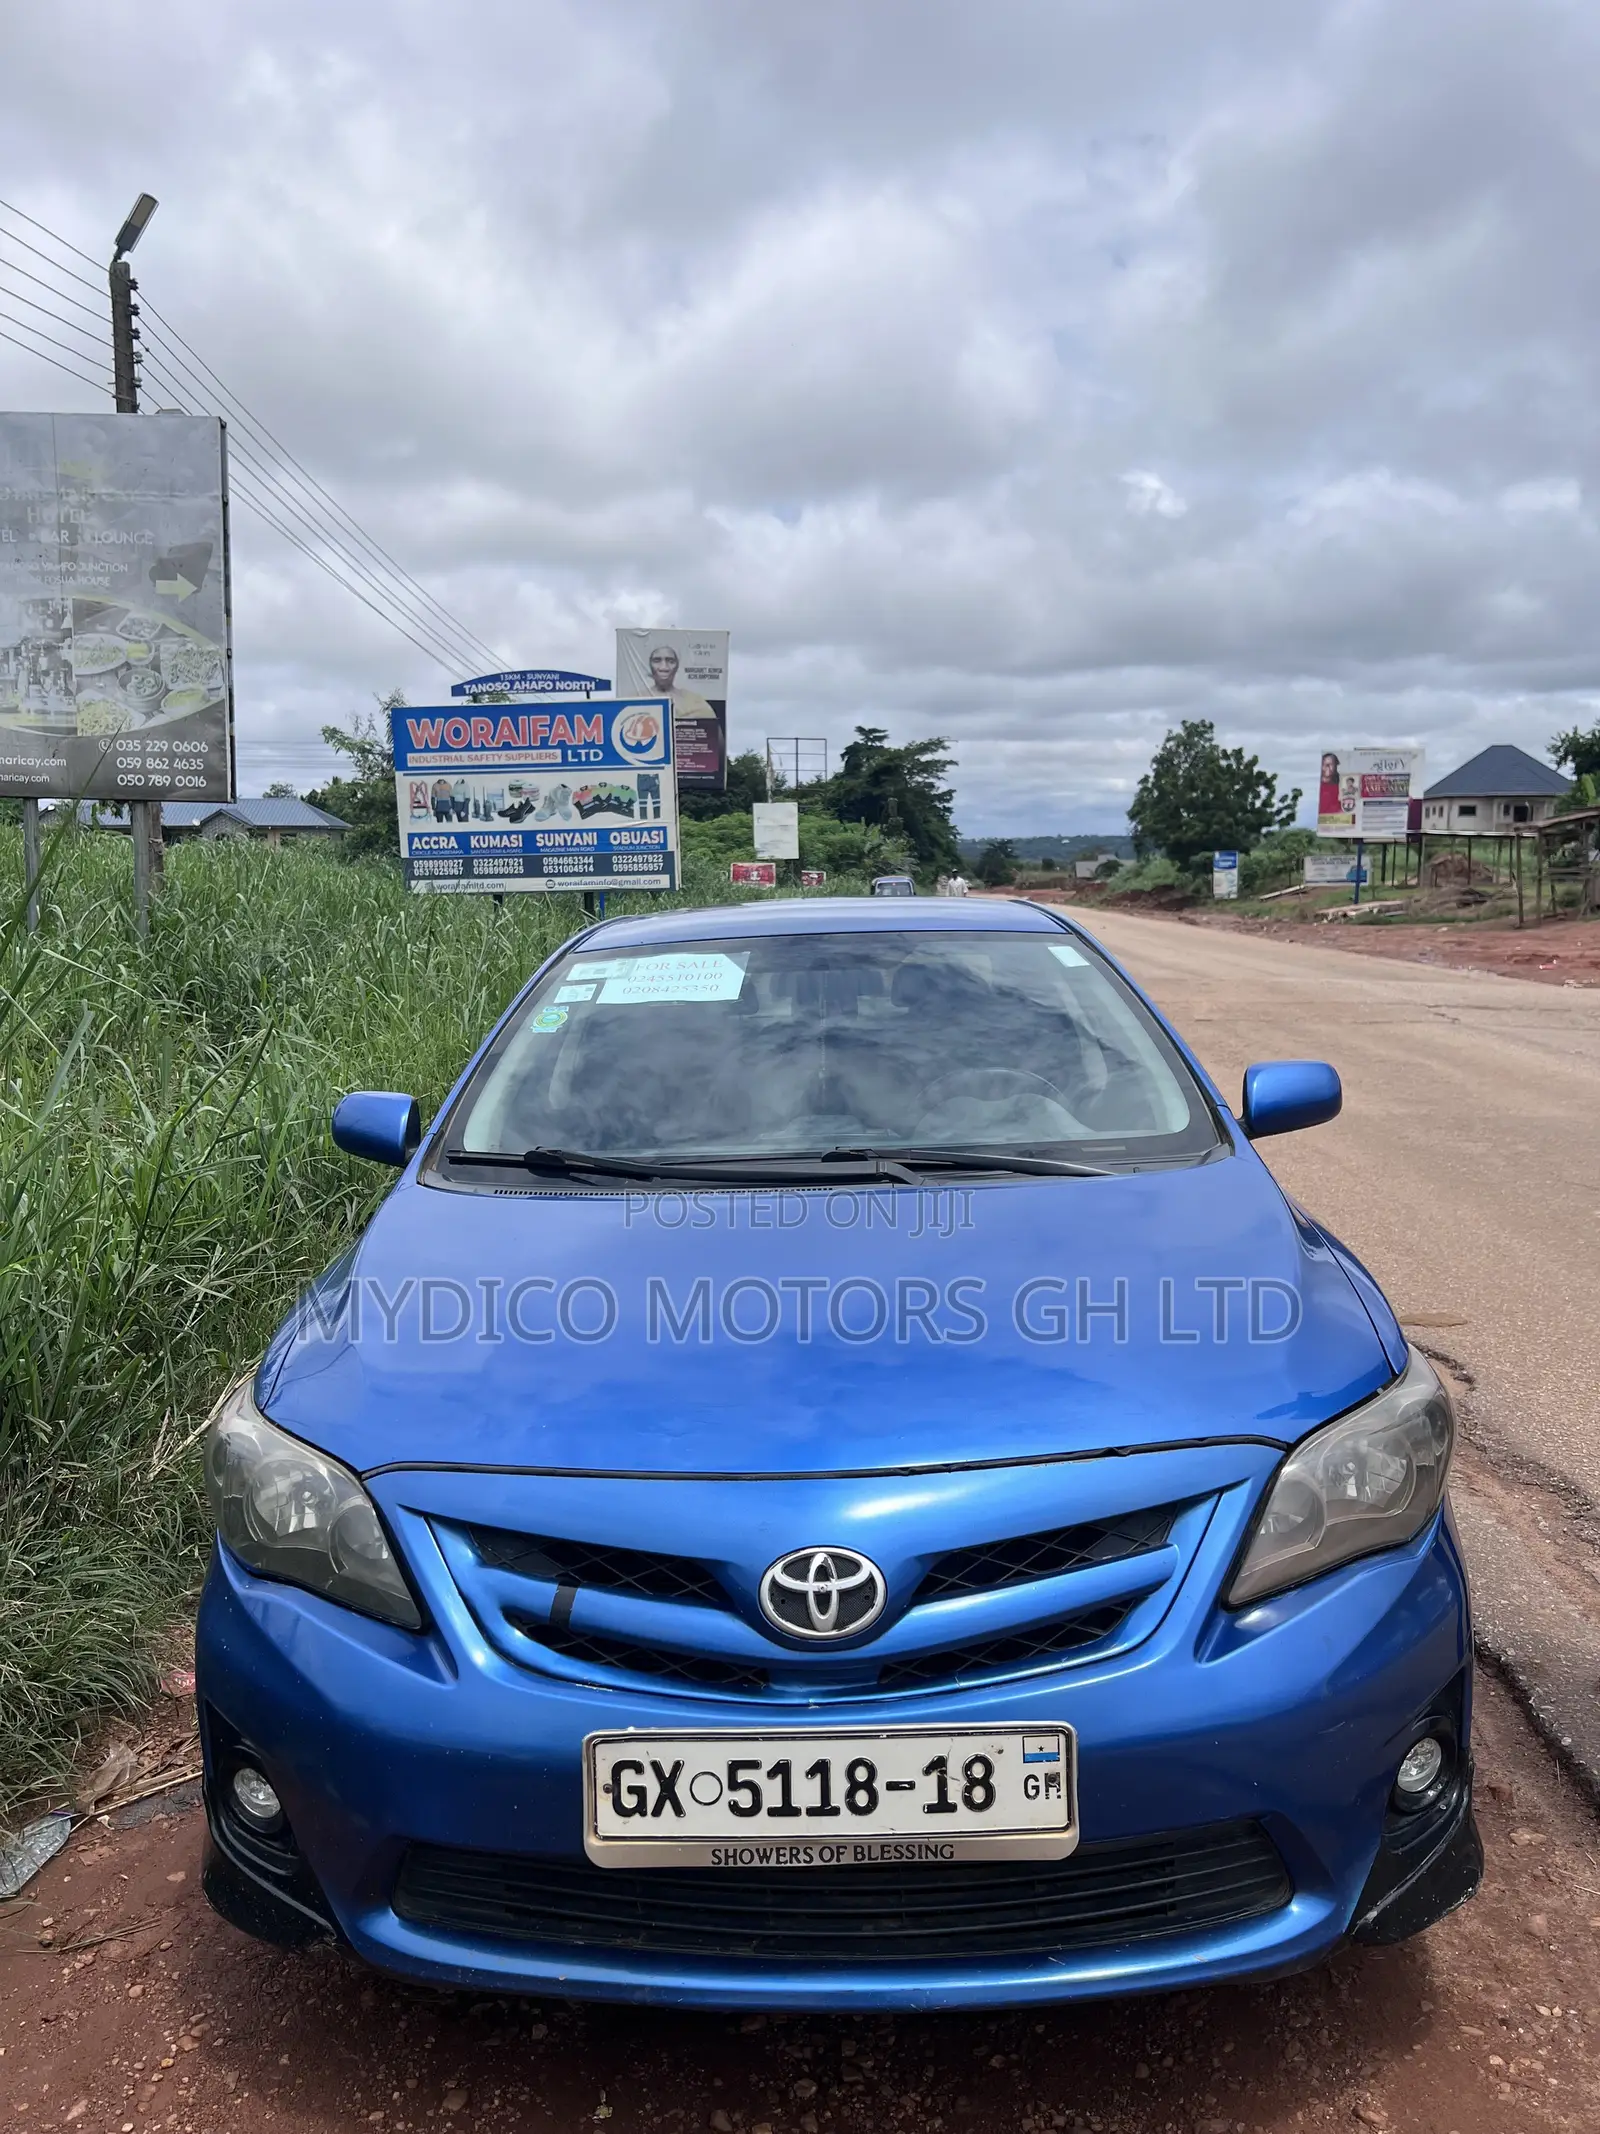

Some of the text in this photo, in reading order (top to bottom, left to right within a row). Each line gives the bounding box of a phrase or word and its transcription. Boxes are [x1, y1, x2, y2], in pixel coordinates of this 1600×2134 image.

[0, 529, 17, 543] EL
[94, 530, 154, 544] LOUNGE
[78, 562, 128, 573] JUNCTION
[78, 576, 111, 587] HOUSE
[527, 673, 560, 681] SUNYANI
[463, 679, 596, 694] TANOSO AHAFO NORTH
[406, 713, 605, 749] WORAIFAM
[116, 740, 209, 753] 035 229 0606
[408, 749, 604, 764] INDUSTRIAL SAFETY SUPPLIERS LTD
[116, 757, 204, 770] 059 862 4635
[117, 774, 207, 788] 050 789 0016
[412, 836, 458, 850] ACCRA
[470, 834, 523, 849] KUMASI
[536, 831, 597, 847] SUNYANI
[610, 830, 664, 845] OBUASI
[413, 859, 464, 869] 0598990927
[473, 858, 523, 867] 0322497921
[543, 856, 594, 866] 0594663344
[612, 854, 663, 864] 0322497922
[473, 866, 524, 875] 0598990925
[543, 864, 594, 874] 0531004514
[613, 862, 663, 873] 0595856957
[636, 962, 670, 972] FOR
[676, 959, 724, 970] SALE
[710, 1843, 955, 1867] SHOWERS OF BLESSING
